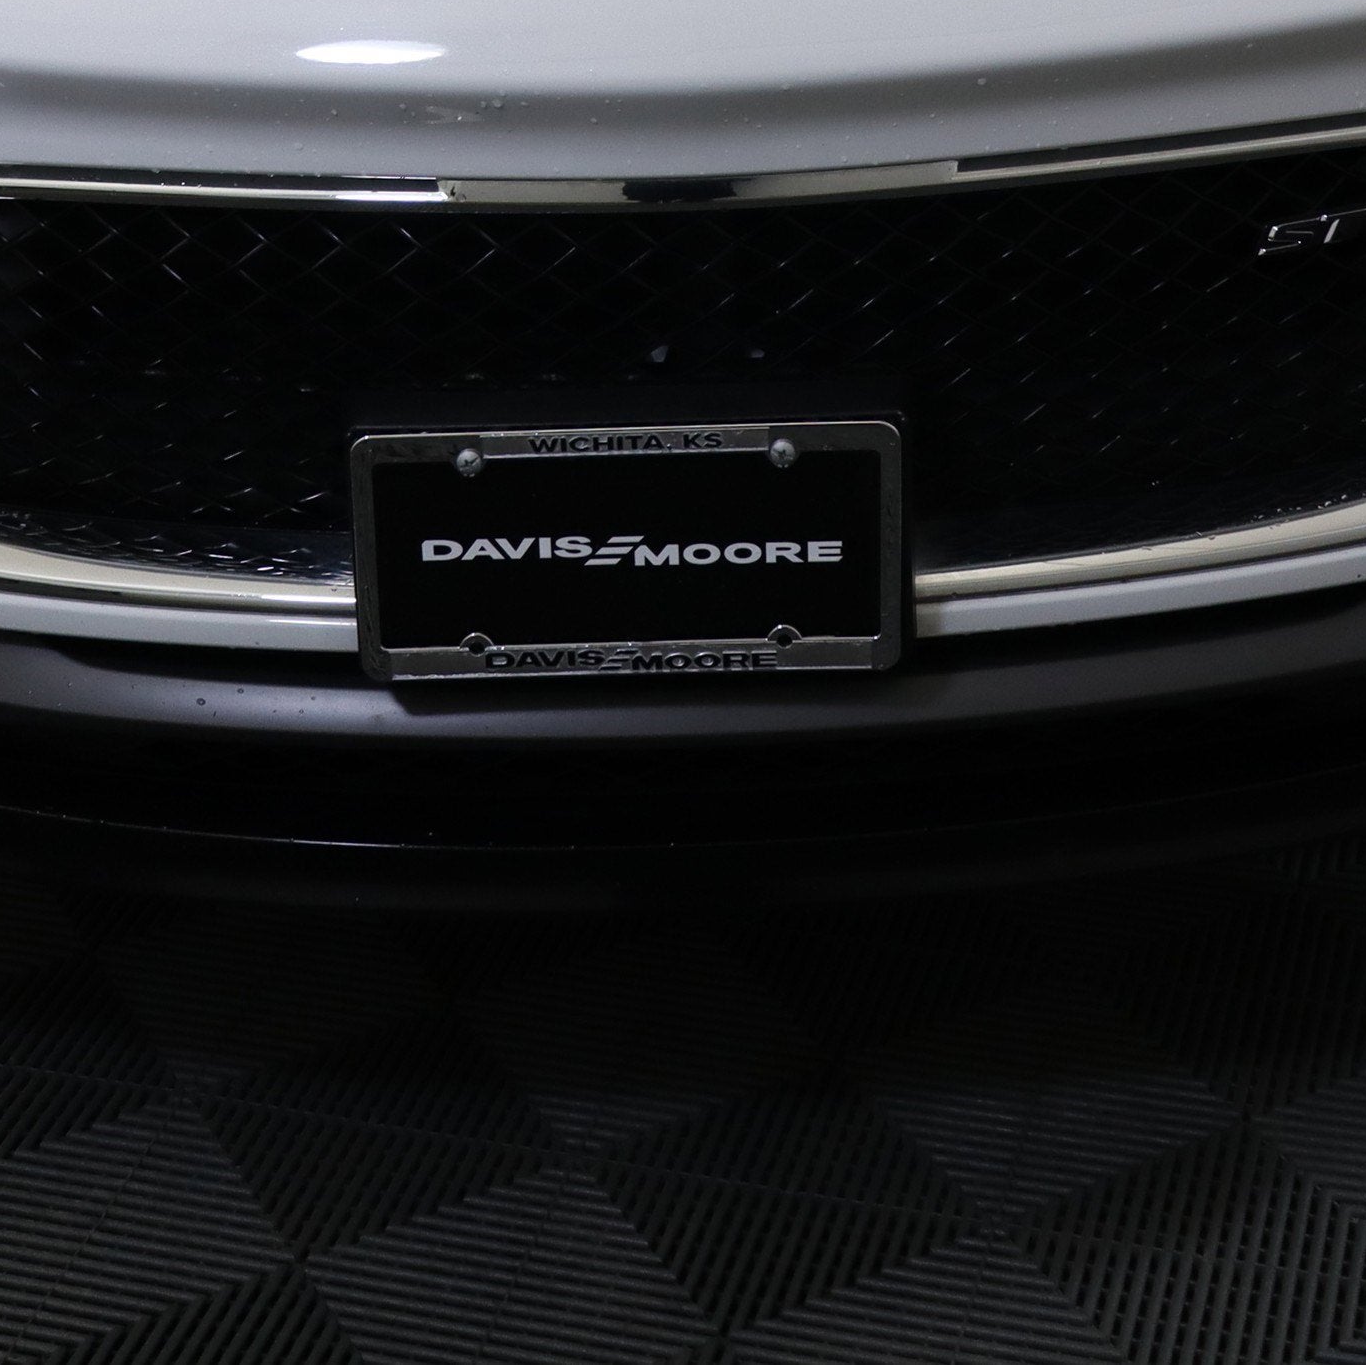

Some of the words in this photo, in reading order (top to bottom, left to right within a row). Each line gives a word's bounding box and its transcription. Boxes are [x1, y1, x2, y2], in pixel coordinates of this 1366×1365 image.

[683, 432, 723, 449] KS
[421, 535, 587, 562] DAVIS
[633, 540, 844, 566] MOORE
[484, 649, 606, 669] DAVIS
[632, 649, 778, 672] MOORE
